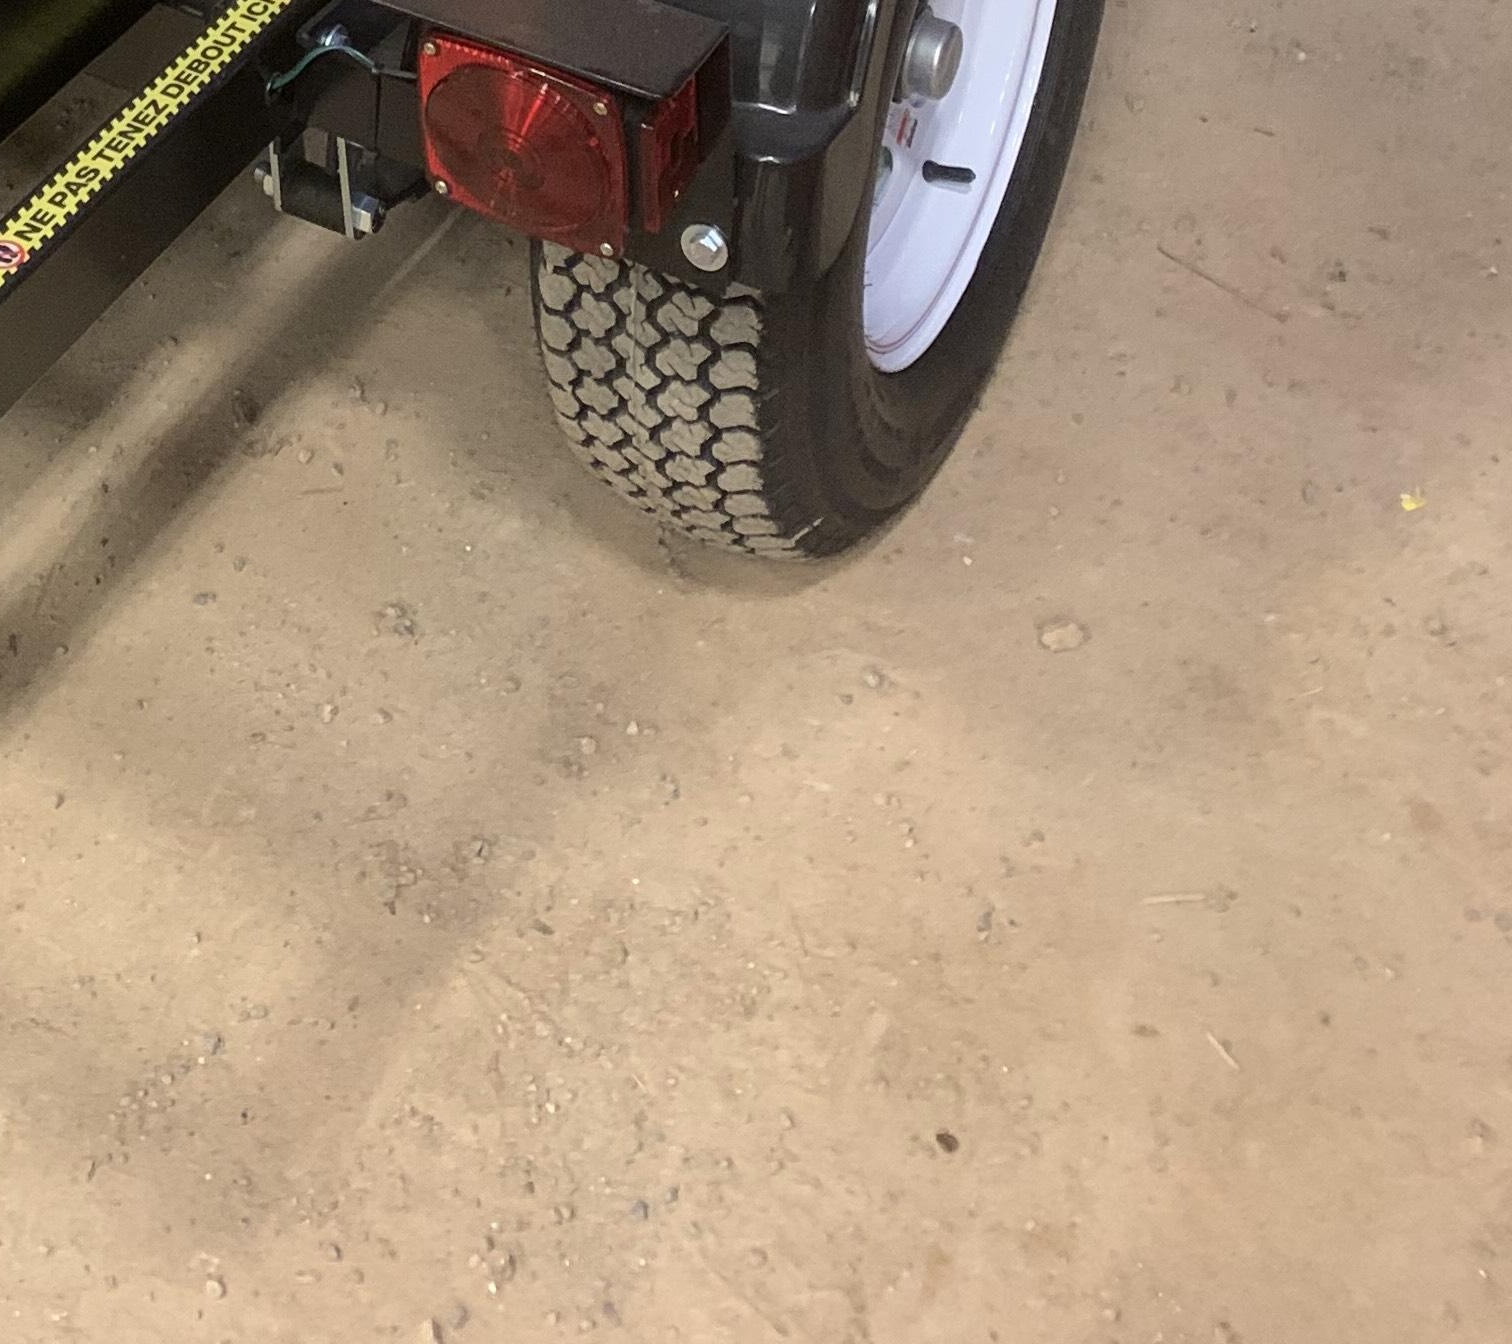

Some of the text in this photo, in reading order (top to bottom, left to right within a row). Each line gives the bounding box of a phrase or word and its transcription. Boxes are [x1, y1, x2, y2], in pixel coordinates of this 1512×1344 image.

[13, 207, 56, 242] NE
[51, 164, 103, 210] PAS
[94, 96, 171, 166] TENEZ
[163, 19, 249, 100] DEBOUT
